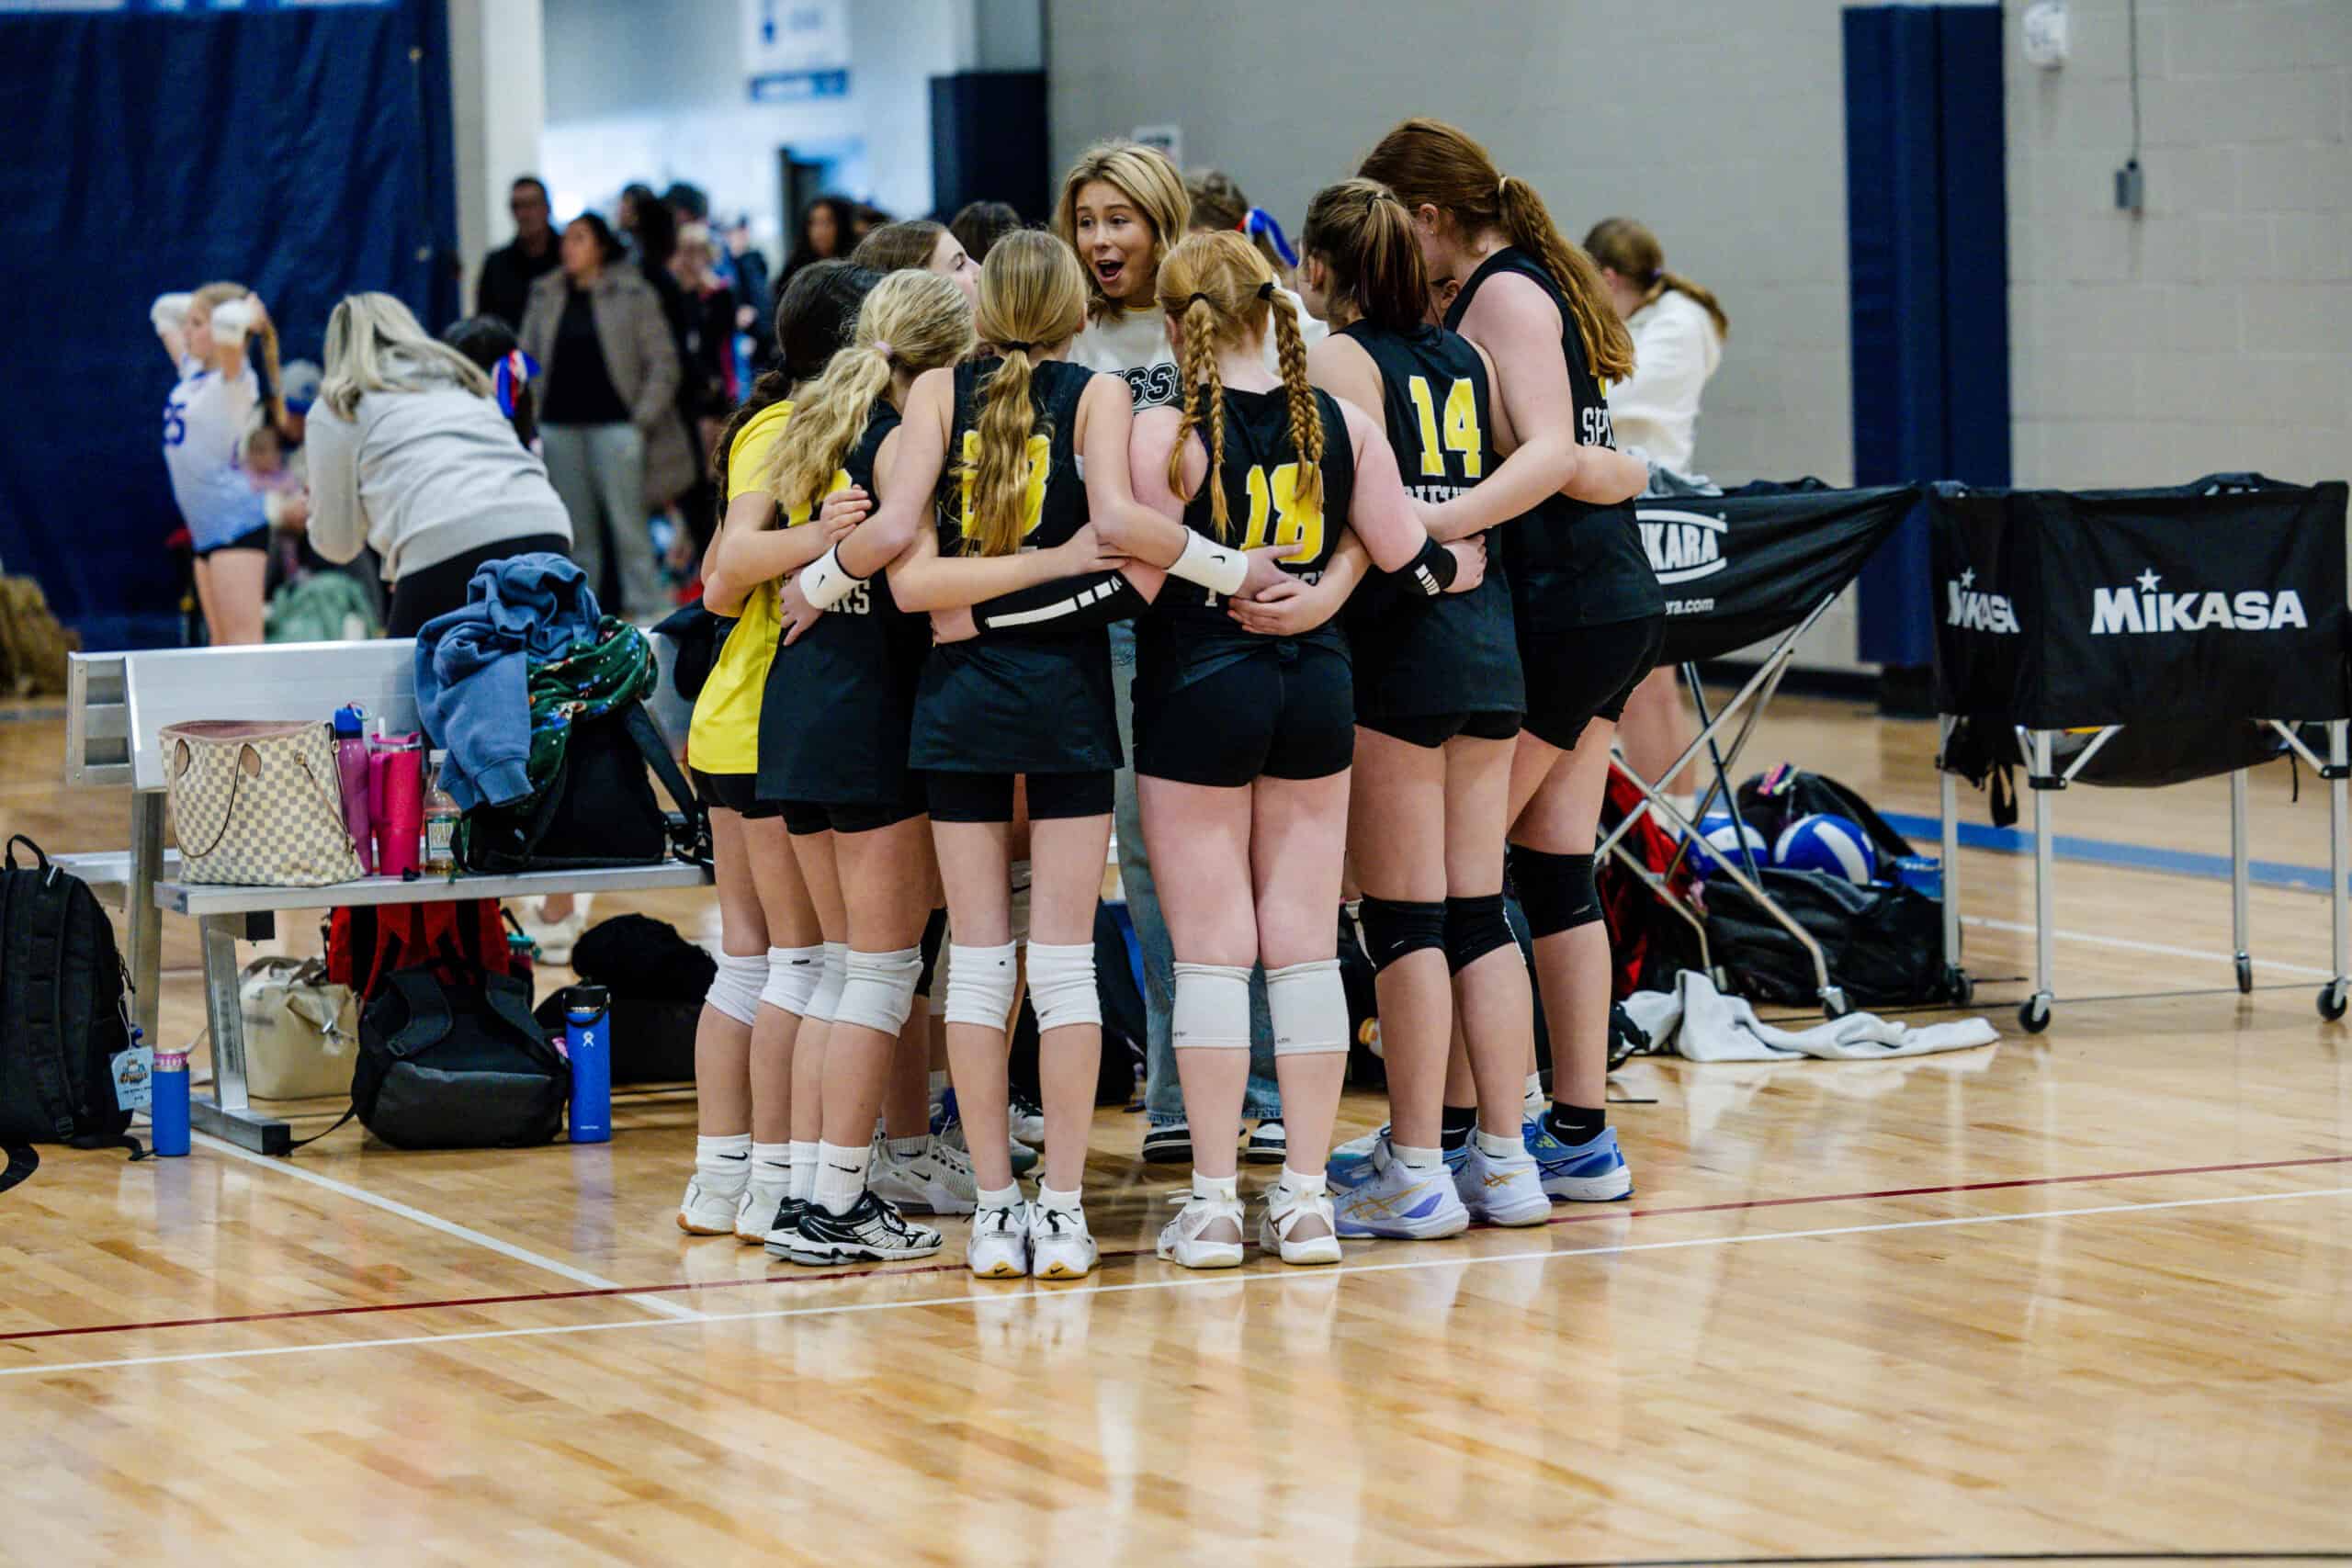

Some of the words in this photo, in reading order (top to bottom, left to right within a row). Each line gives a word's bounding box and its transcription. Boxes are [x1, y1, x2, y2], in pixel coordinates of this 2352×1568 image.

[1409, 375, 1482, 478] 14
[1638, 523, 1719, 570] KARA
[1665, 598, 1714, 615] ra.com
